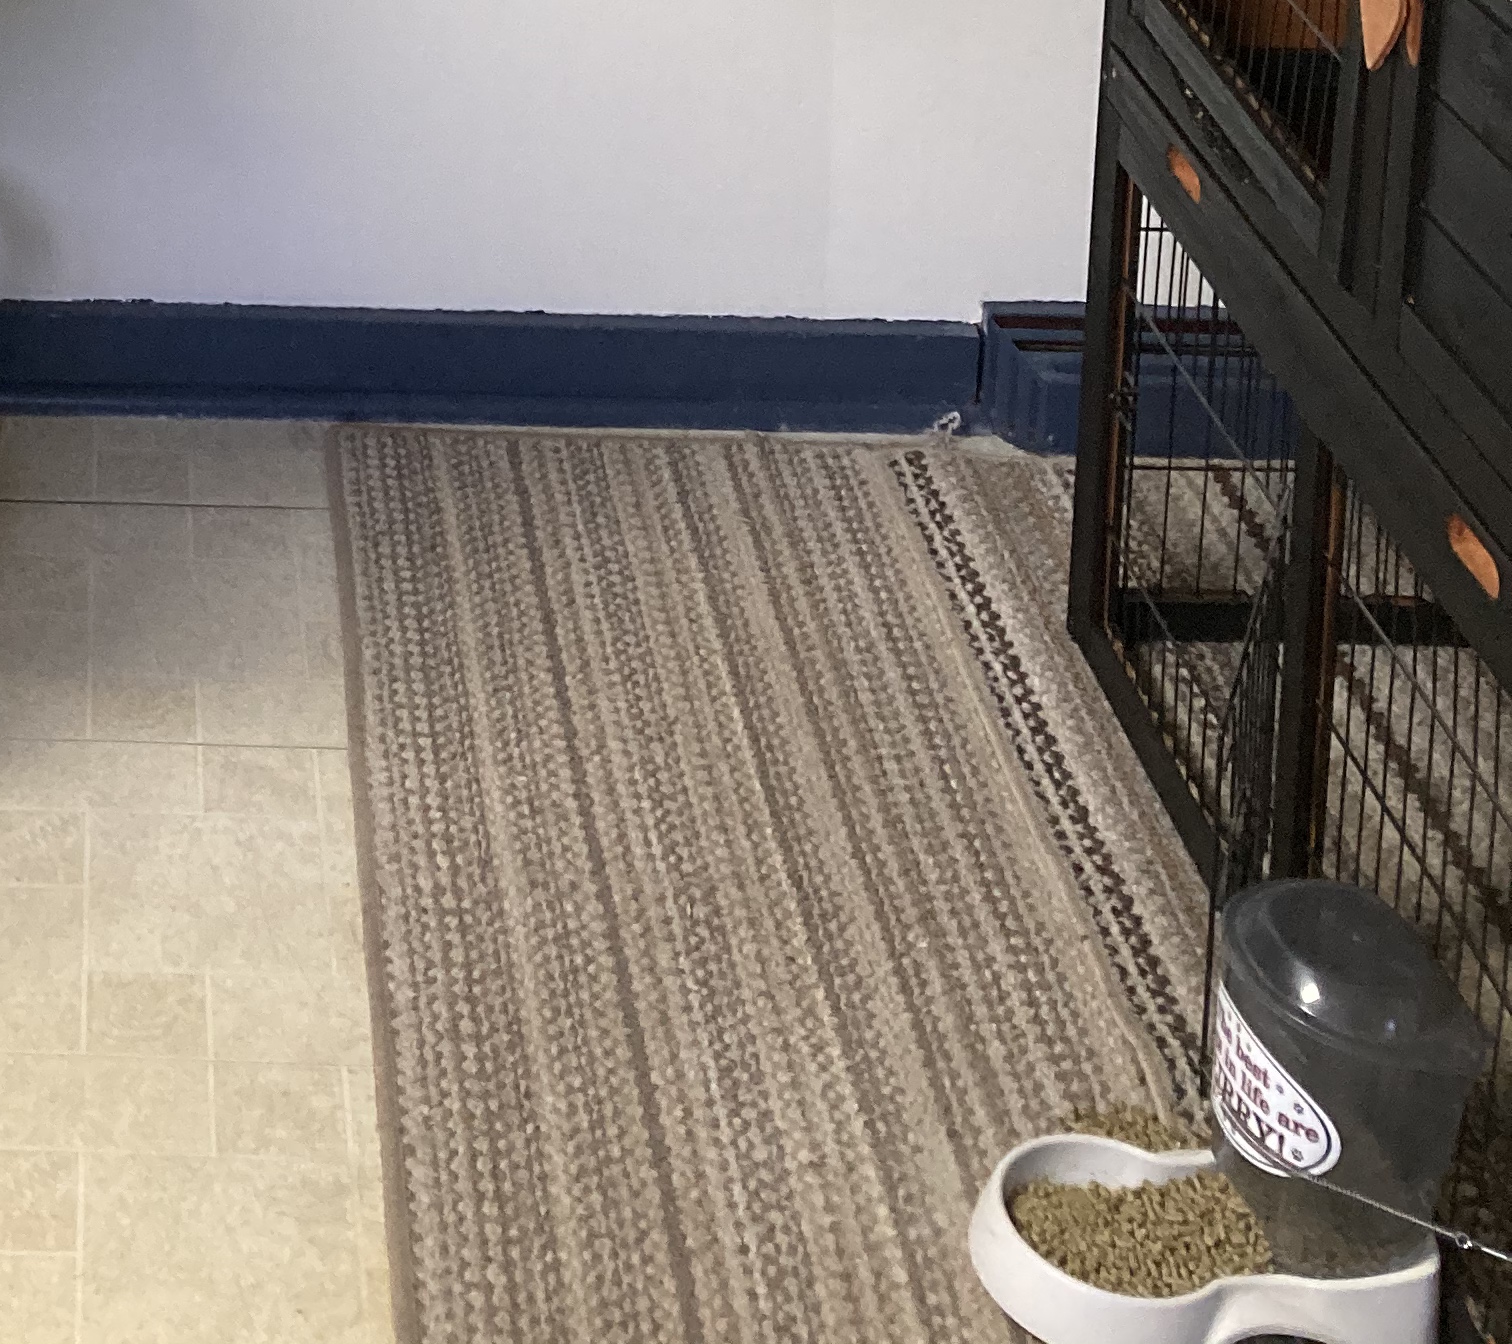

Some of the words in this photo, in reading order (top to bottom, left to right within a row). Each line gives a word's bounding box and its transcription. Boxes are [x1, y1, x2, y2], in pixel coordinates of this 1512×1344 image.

[1236, 1034, 1270, 1090] best
[1241, 1070, 1270, 1116] life
[1277, 1112, 1320, 1144] are
